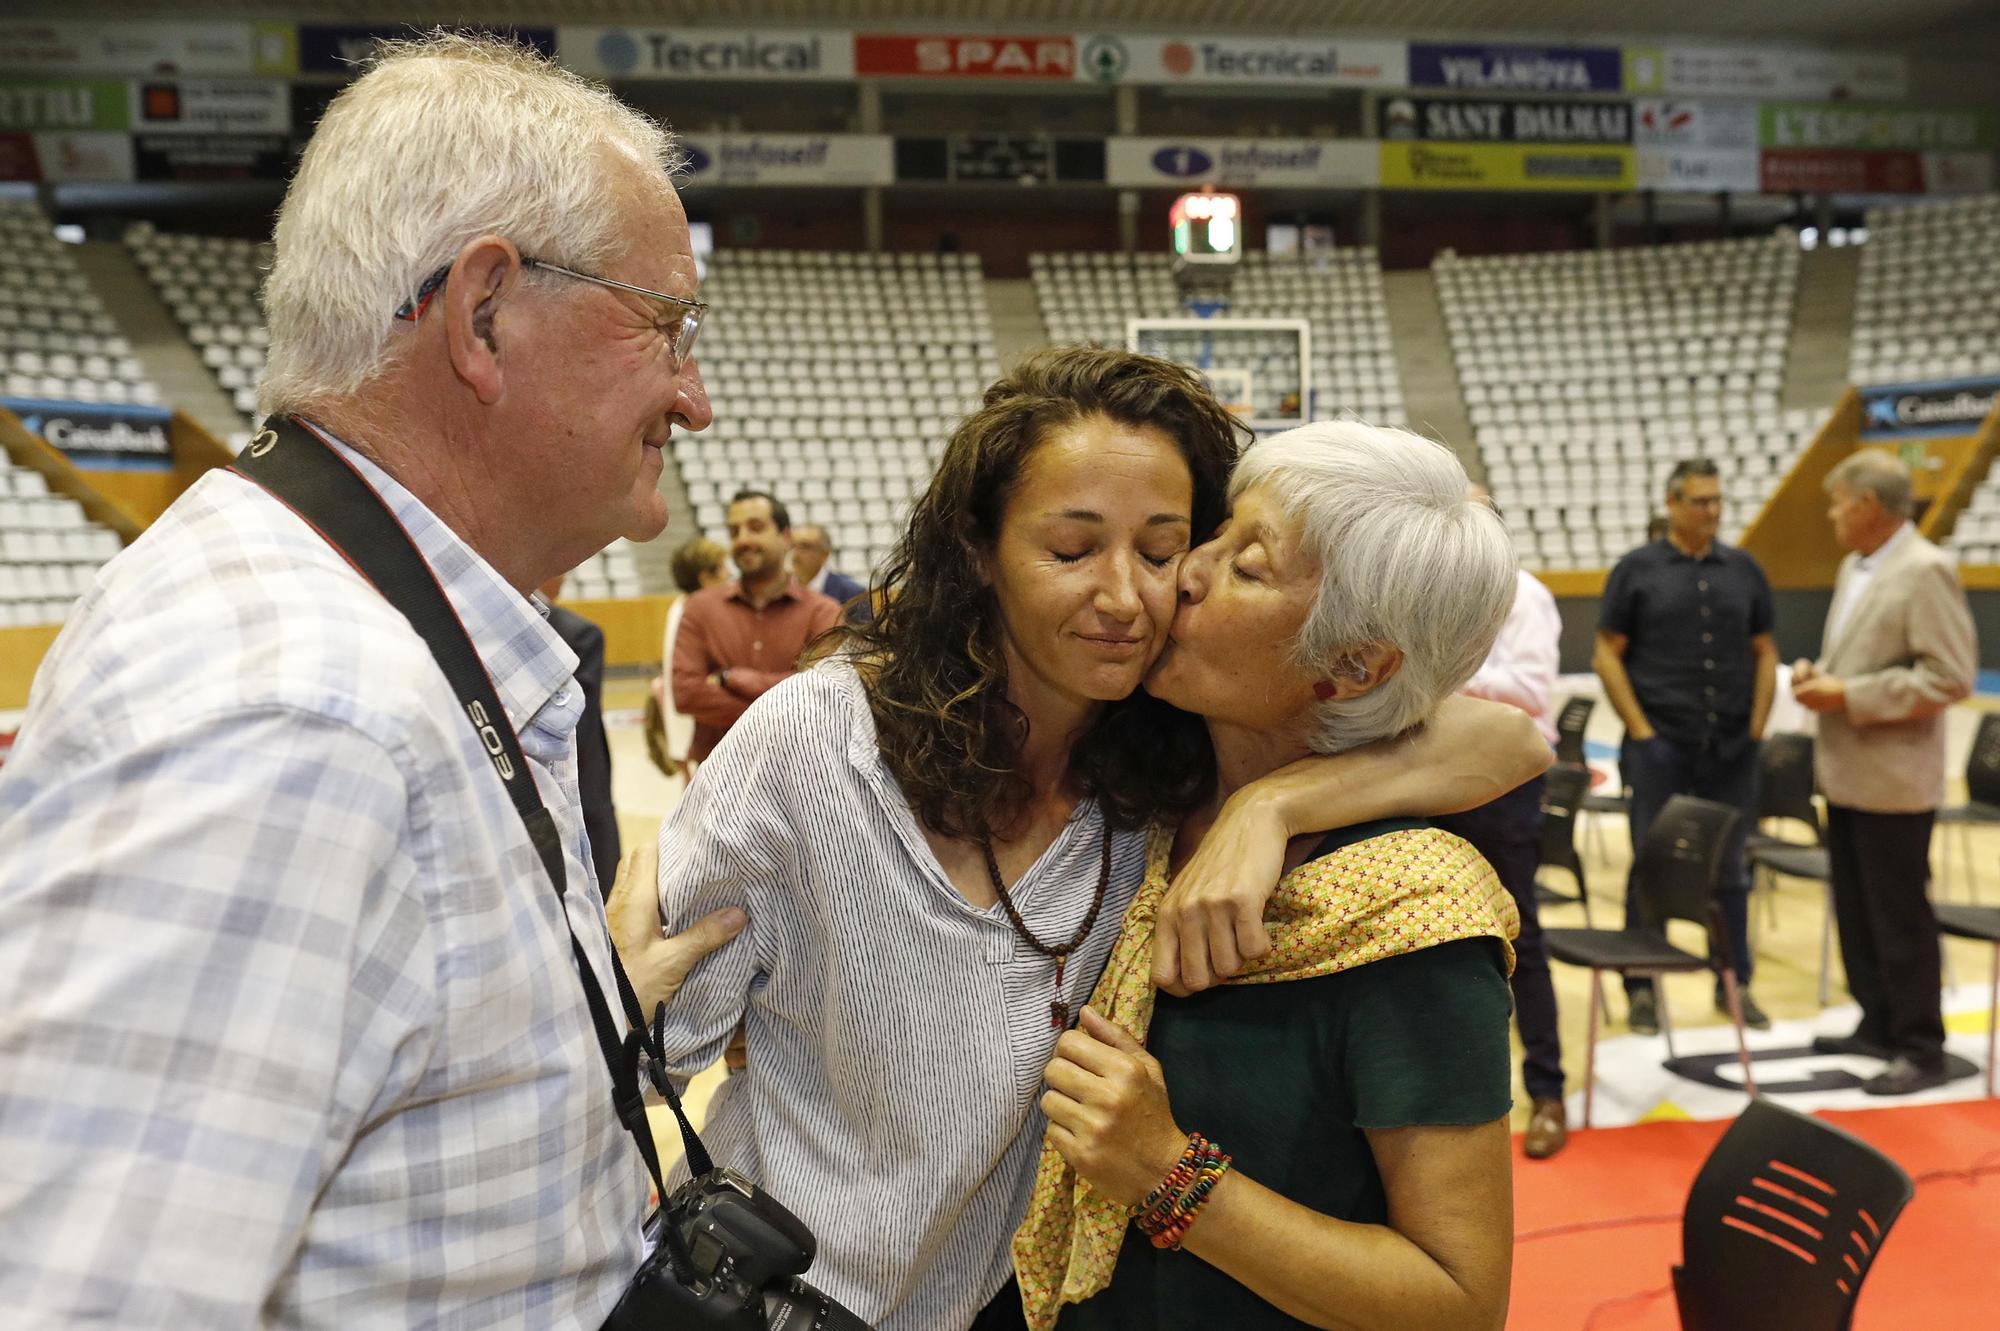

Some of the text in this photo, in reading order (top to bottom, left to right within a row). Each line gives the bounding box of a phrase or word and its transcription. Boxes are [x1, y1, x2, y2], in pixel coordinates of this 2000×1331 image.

[647, 34, 820, 70] Tecnical
[915, 40, 1071, 71] SPAR
[1201, 43, 1338, 75] Tecnical
[1426, 103, 1502, 139] SANT
[466, 699, 516, 781] EOS
